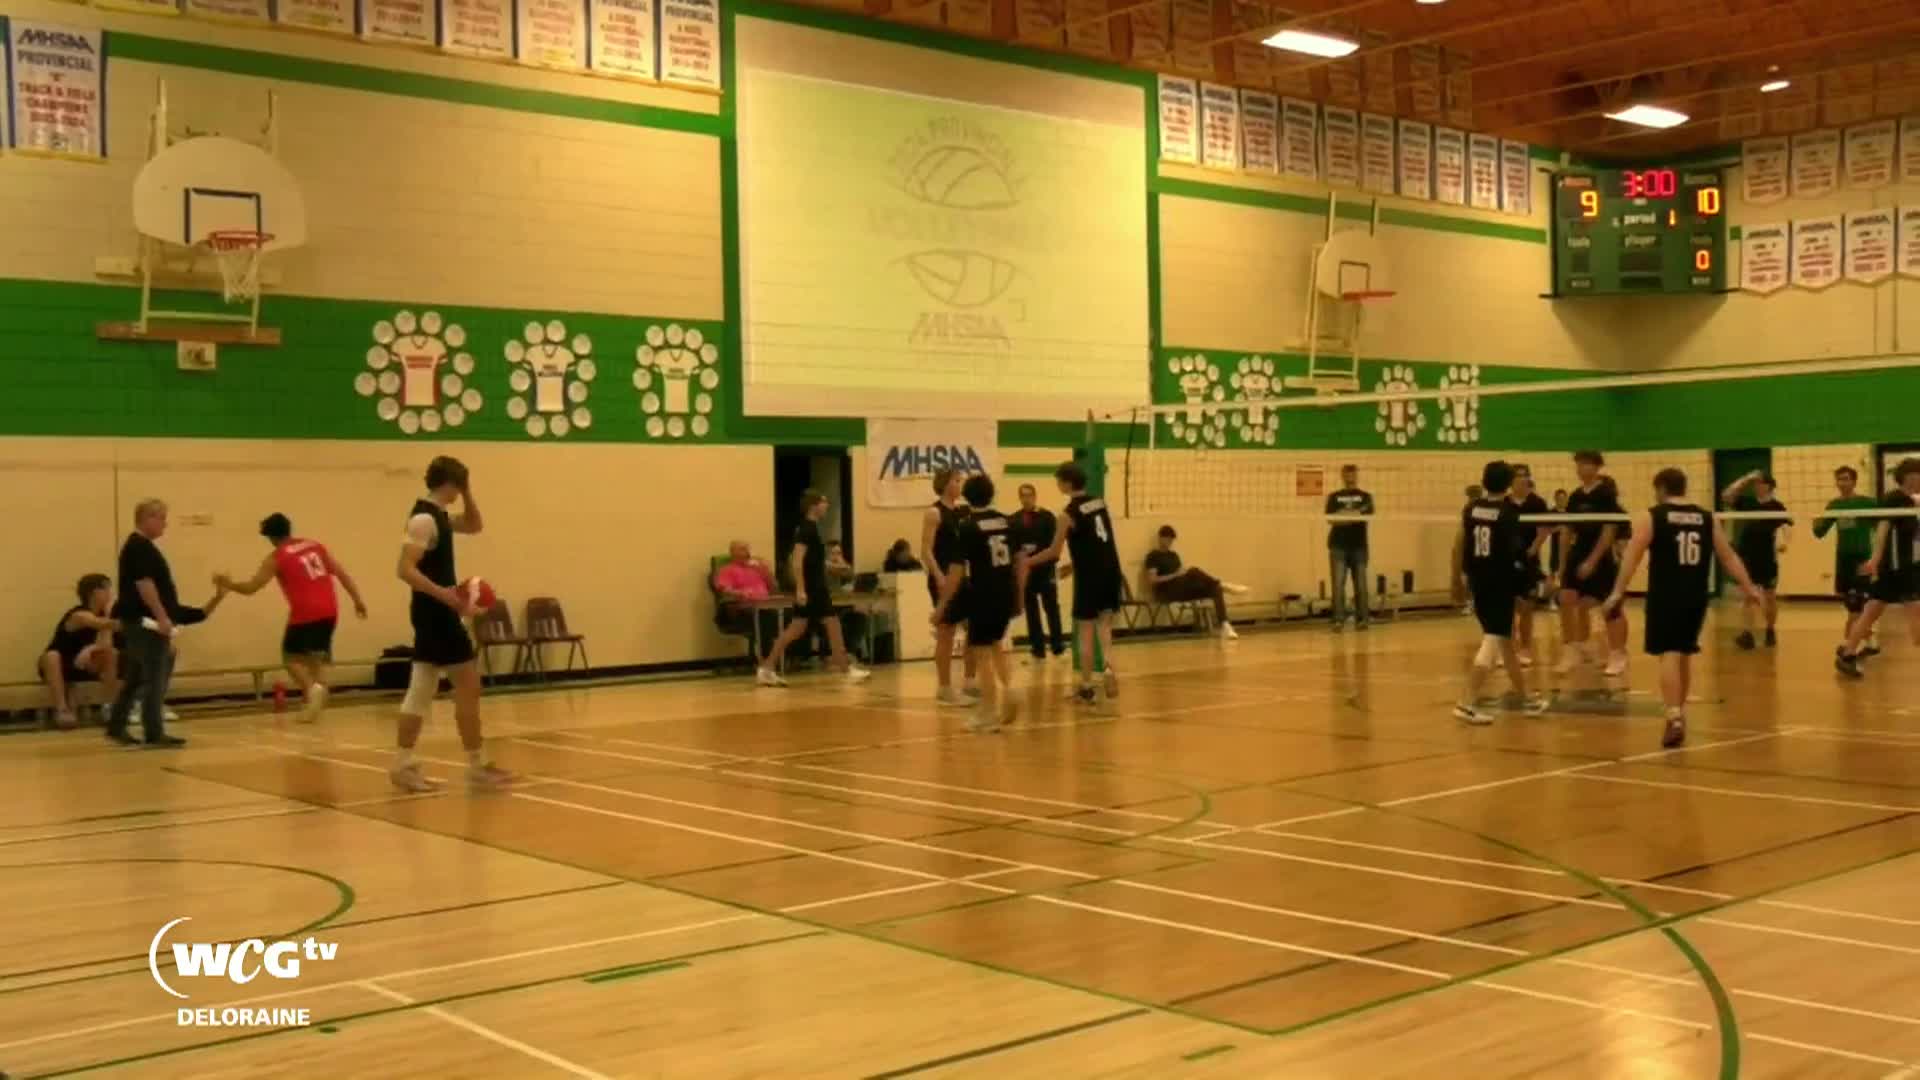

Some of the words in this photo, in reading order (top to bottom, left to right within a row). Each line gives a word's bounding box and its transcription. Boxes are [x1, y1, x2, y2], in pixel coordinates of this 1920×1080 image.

[1623, 170, 1675, 198] 3:00
[1580, 190, 1598, 217] 9
[1697, 187, 1720, 214] 10
[1696, 250, 1710, 270] 0
[879, 445, 986, 481] MHSAA
[1094, 514, 1108, 543] 4
[1473, 524, 1491, 557] 18
[988, 534, 1011, 567] 15
[1675, 530, 1701, 566] 16
